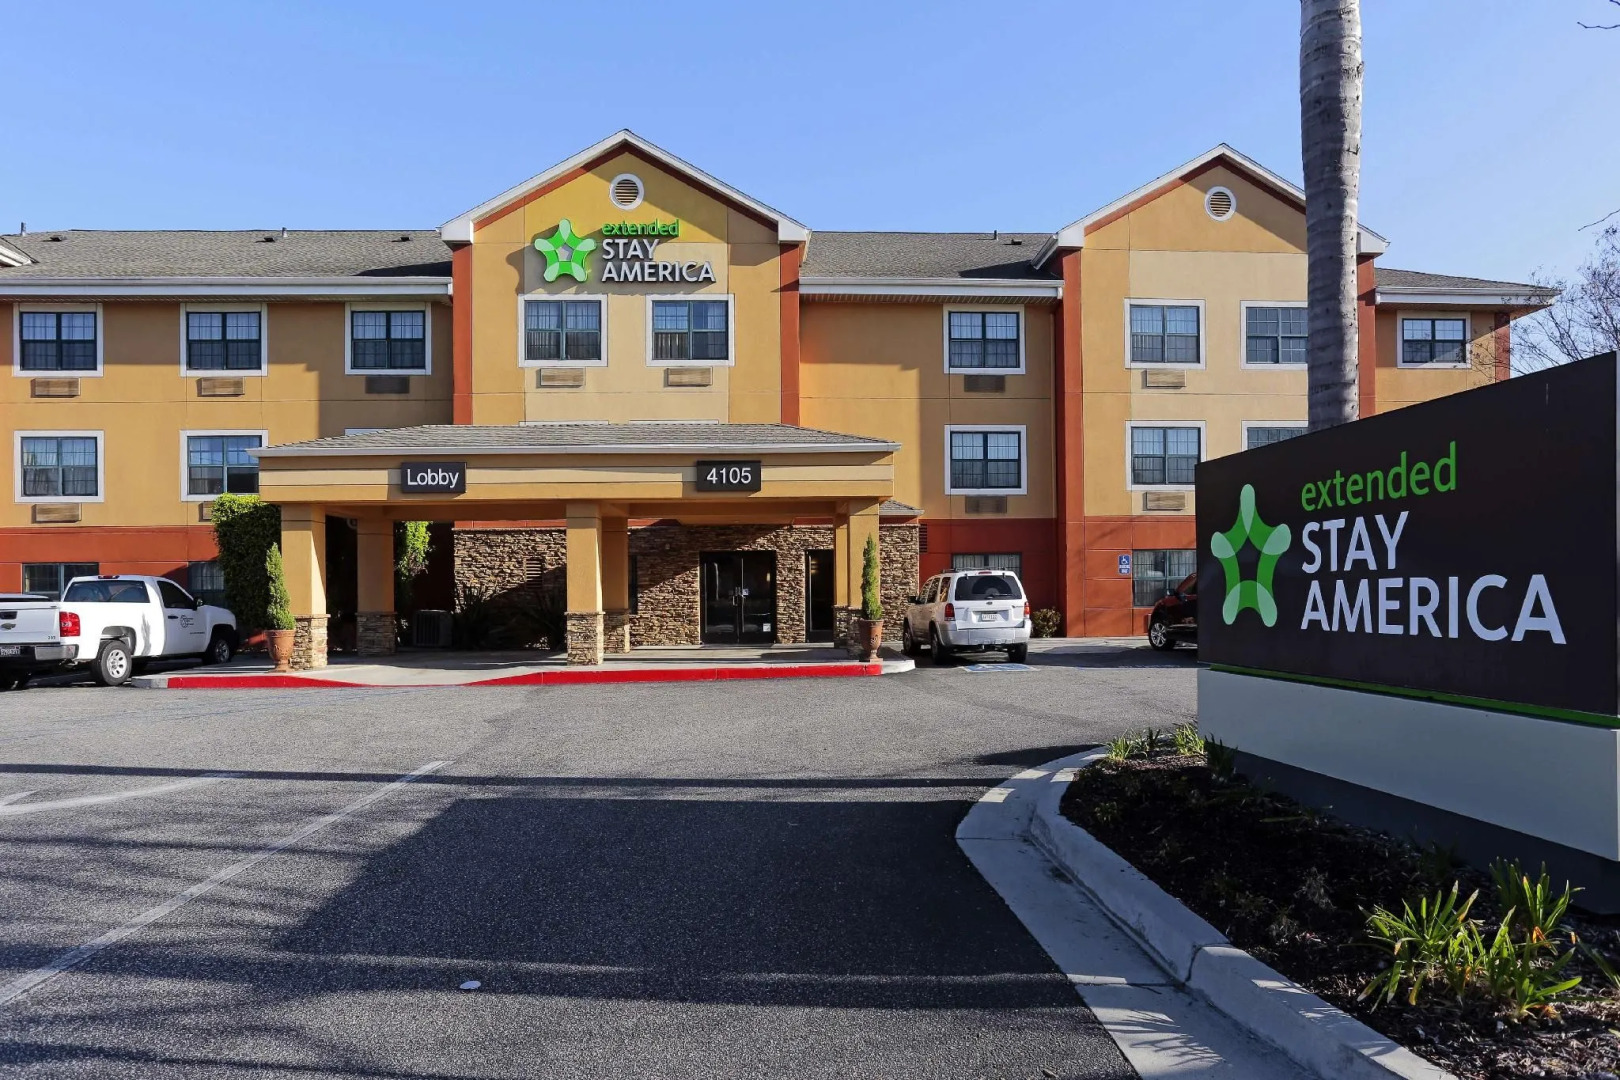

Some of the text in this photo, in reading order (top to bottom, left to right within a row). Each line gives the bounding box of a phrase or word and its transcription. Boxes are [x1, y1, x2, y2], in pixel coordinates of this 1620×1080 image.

[602, 219, 680, 236] extended
[602, 239, 660, 260] STAY
[601, 261, 716, 283] AMERICA
[407, 468, 460, 489] Lobby
[706, 467, 752, 484] 4105
[1301, 441, 1457, 512] extended
[1301, 511, 1410, 574] STAY
[1300, 574, 1568, 645] AMERICA
